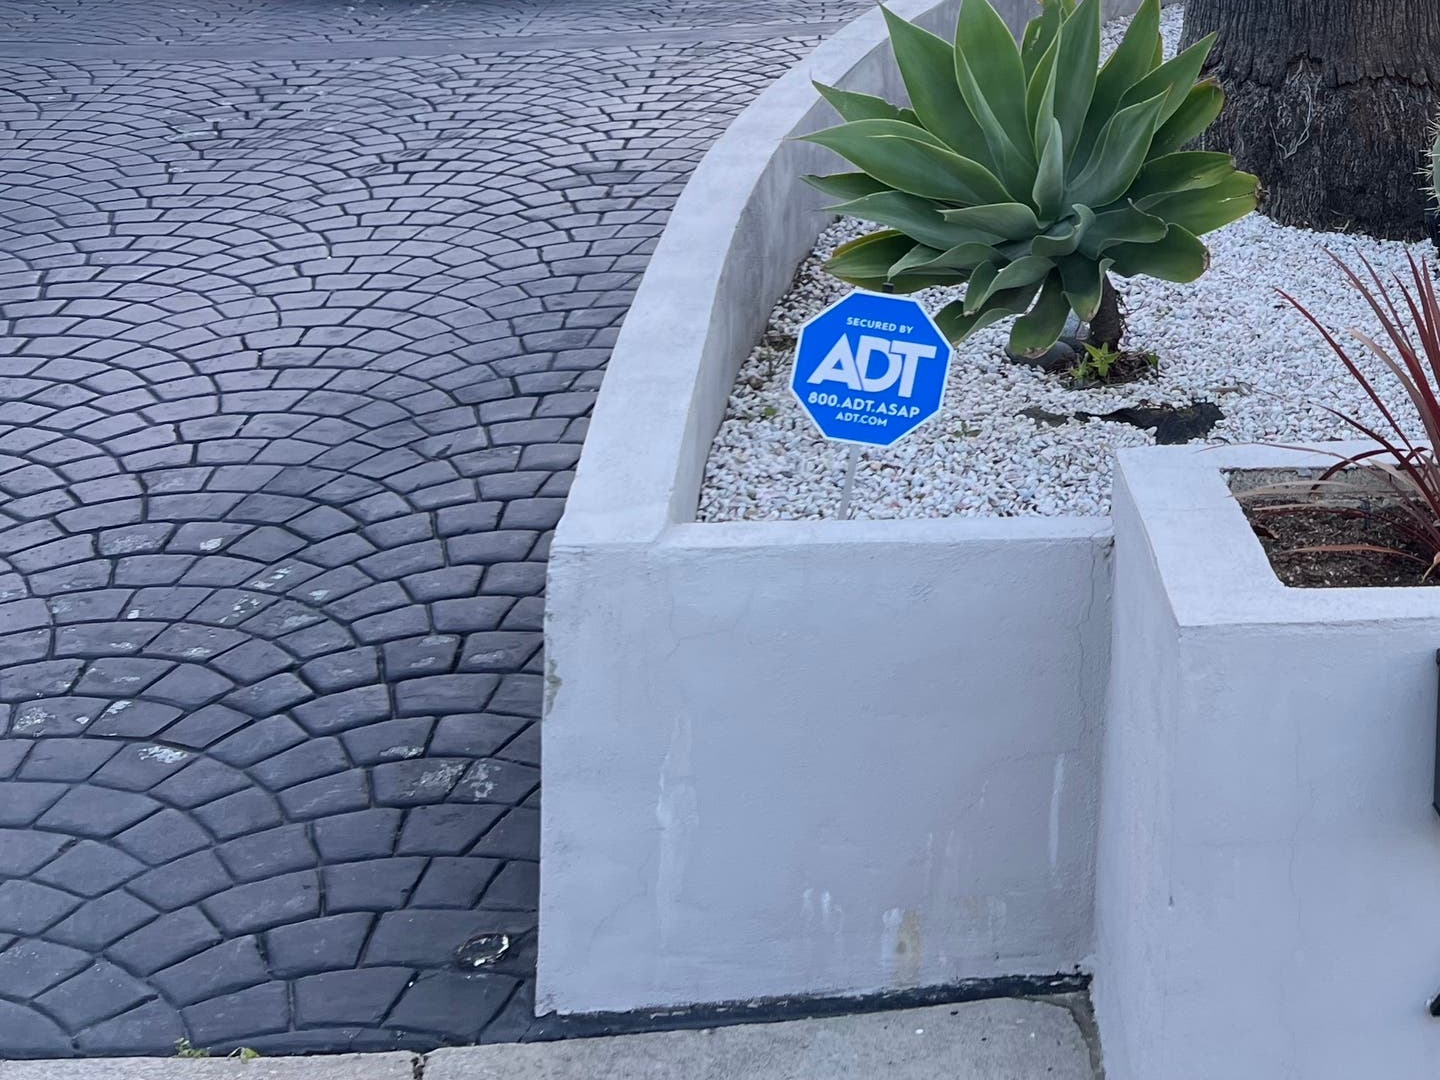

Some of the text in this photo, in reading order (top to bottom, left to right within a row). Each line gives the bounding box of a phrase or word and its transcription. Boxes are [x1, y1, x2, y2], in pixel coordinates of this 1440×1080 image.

[846, 317, 914, 334] SECURED BY
[806, 332, 937, 398] ADT
[807, 391, 920, 419] 800.ADT.ASAP
[835, 411, 888, 427] ADT.COM
